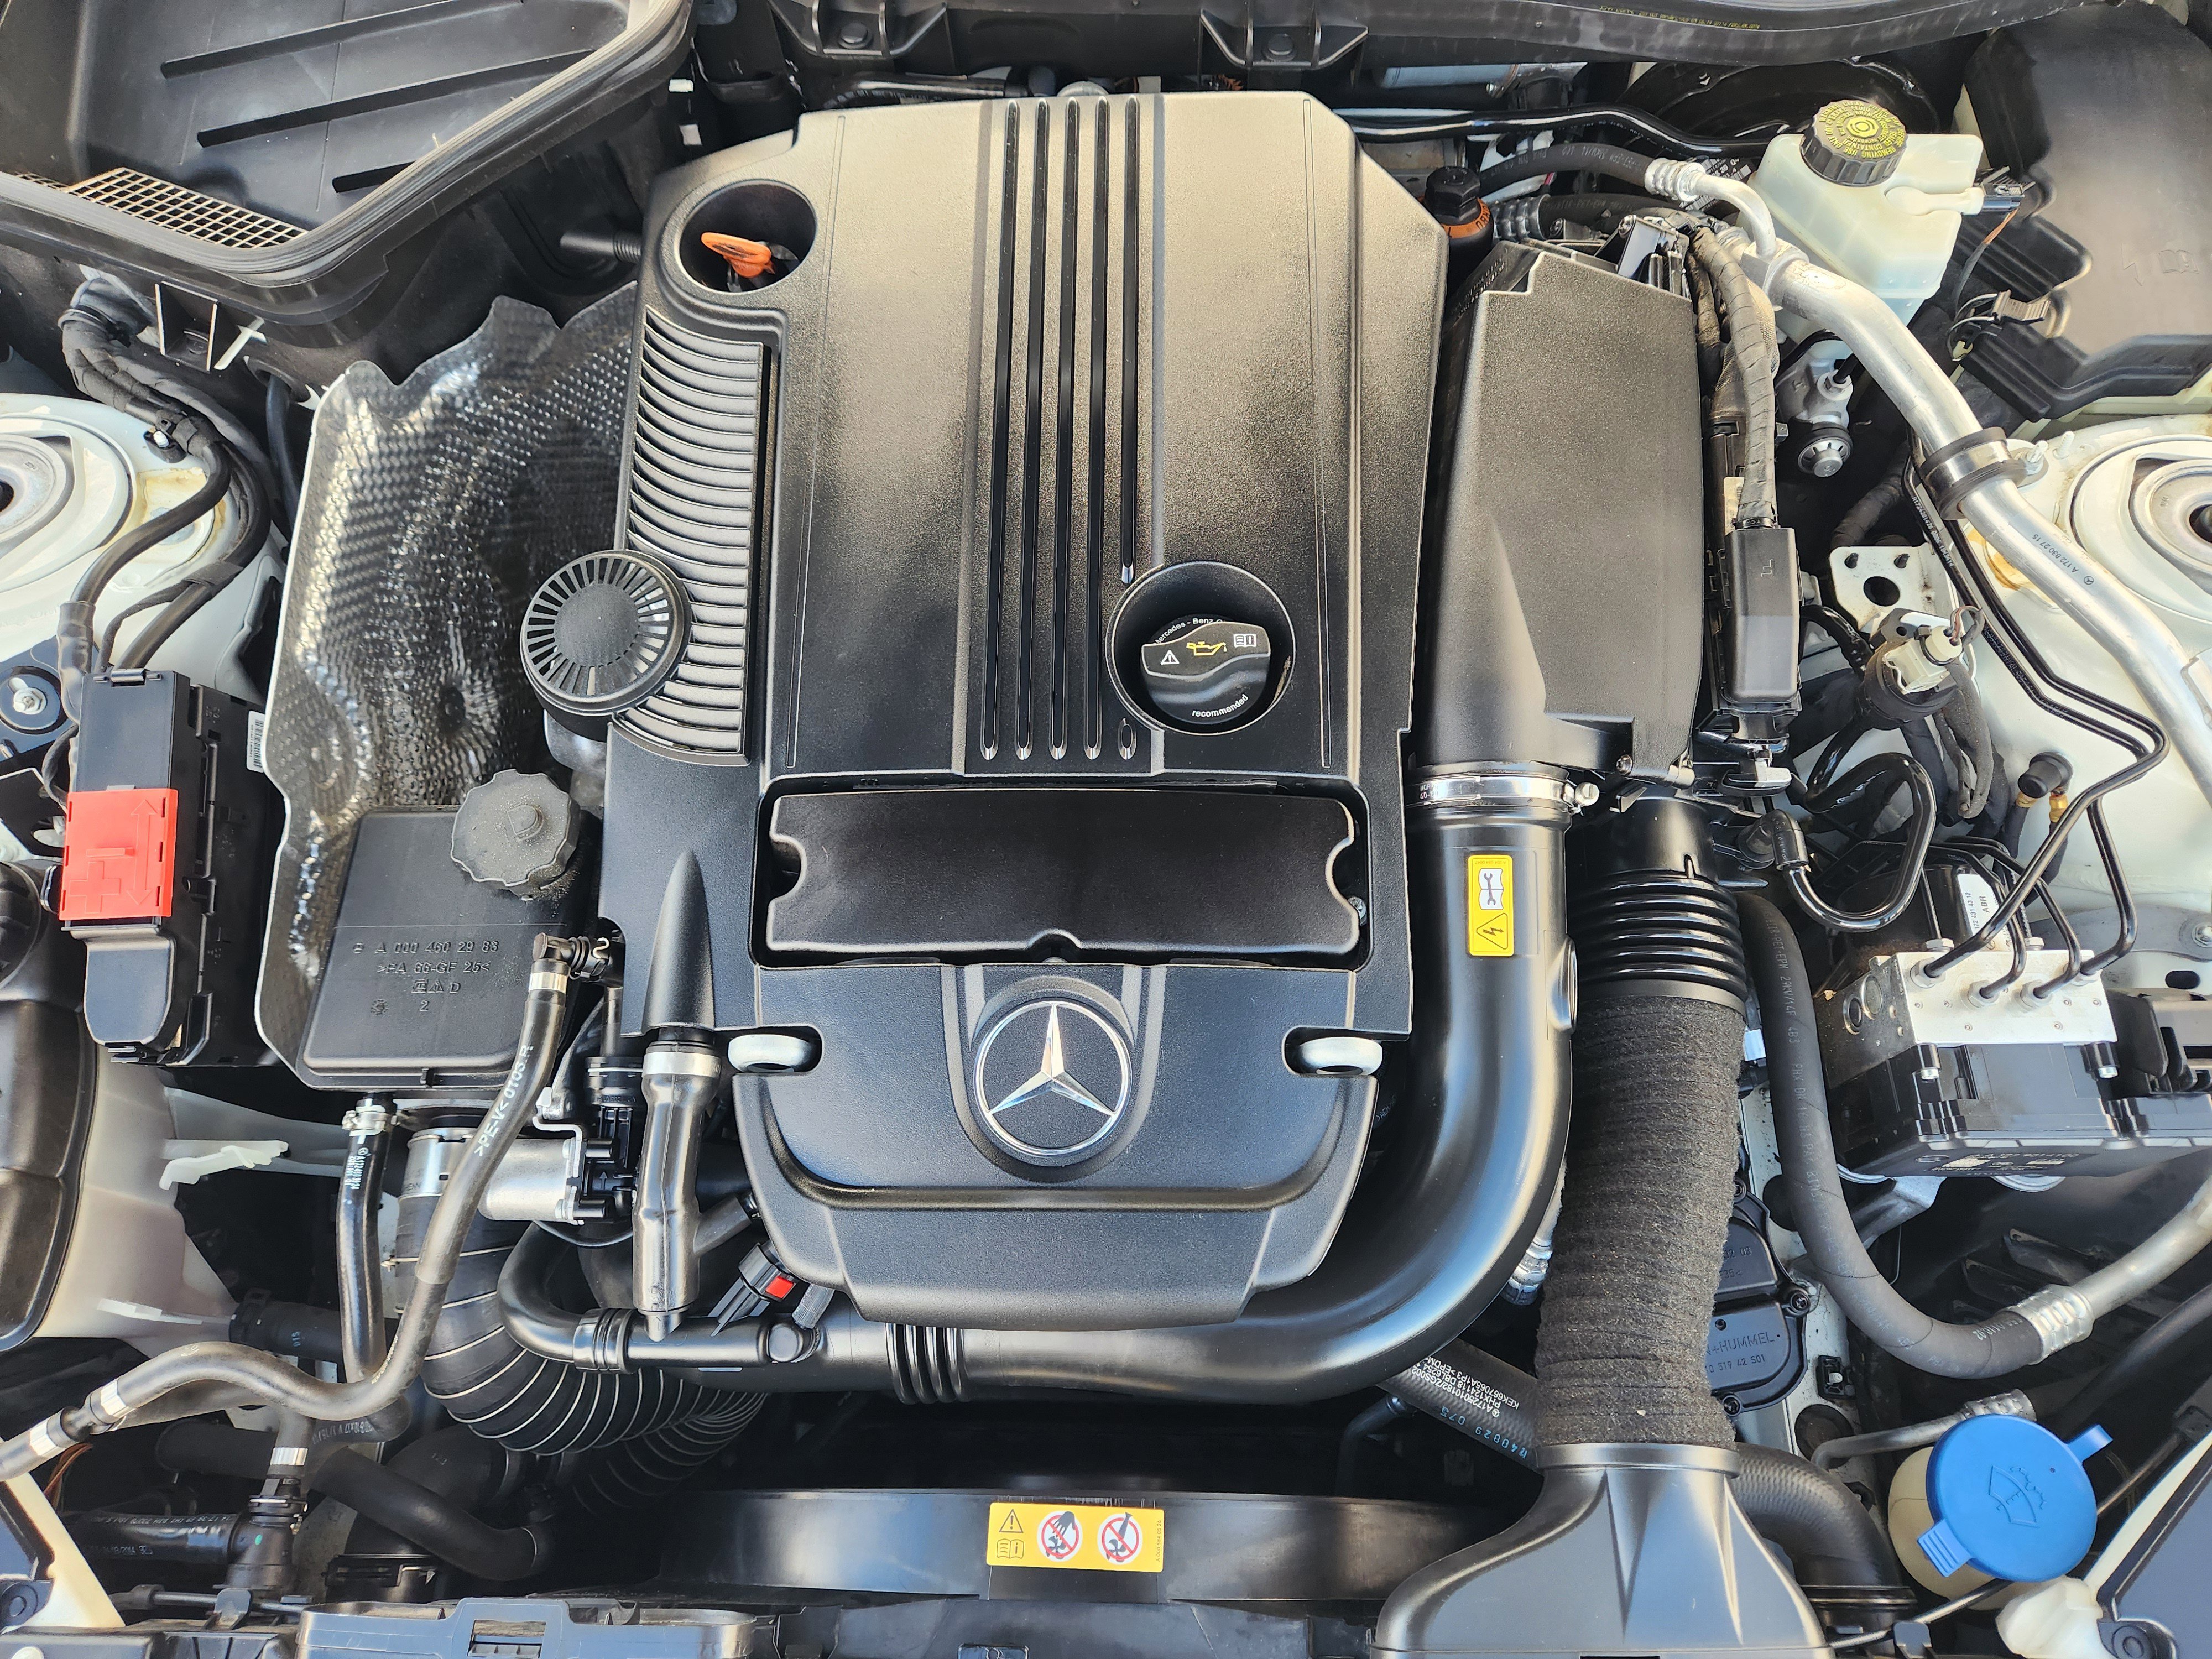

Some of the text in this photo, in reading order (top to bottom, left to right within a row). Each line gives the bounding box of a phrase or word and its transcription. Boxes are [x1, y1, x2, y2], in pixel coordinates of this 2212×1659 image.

[2032, 534, 2042, 542] 15
[2048, 547, 2062, 559] 830
[2060, 557, 2073, 568] 172
[1192, 693, 1249, 717] recommended
[1979, 896, 1990, 914] ABR
[1972, 920, 1980, 929] 172
[375, 940, 499, 953] A 000 460 29 83
[377, 961, 491, 974] >PA 66-GF 25<
[419, 1000, 430, 1011] 2
[1718, 1360, 1732, 1372] 519
[1737, 1358, 1747, 1366] 42
[1751, 1354, 1766, 1364] S01
[1457, 1382, 1501, 1409] PHX124118
